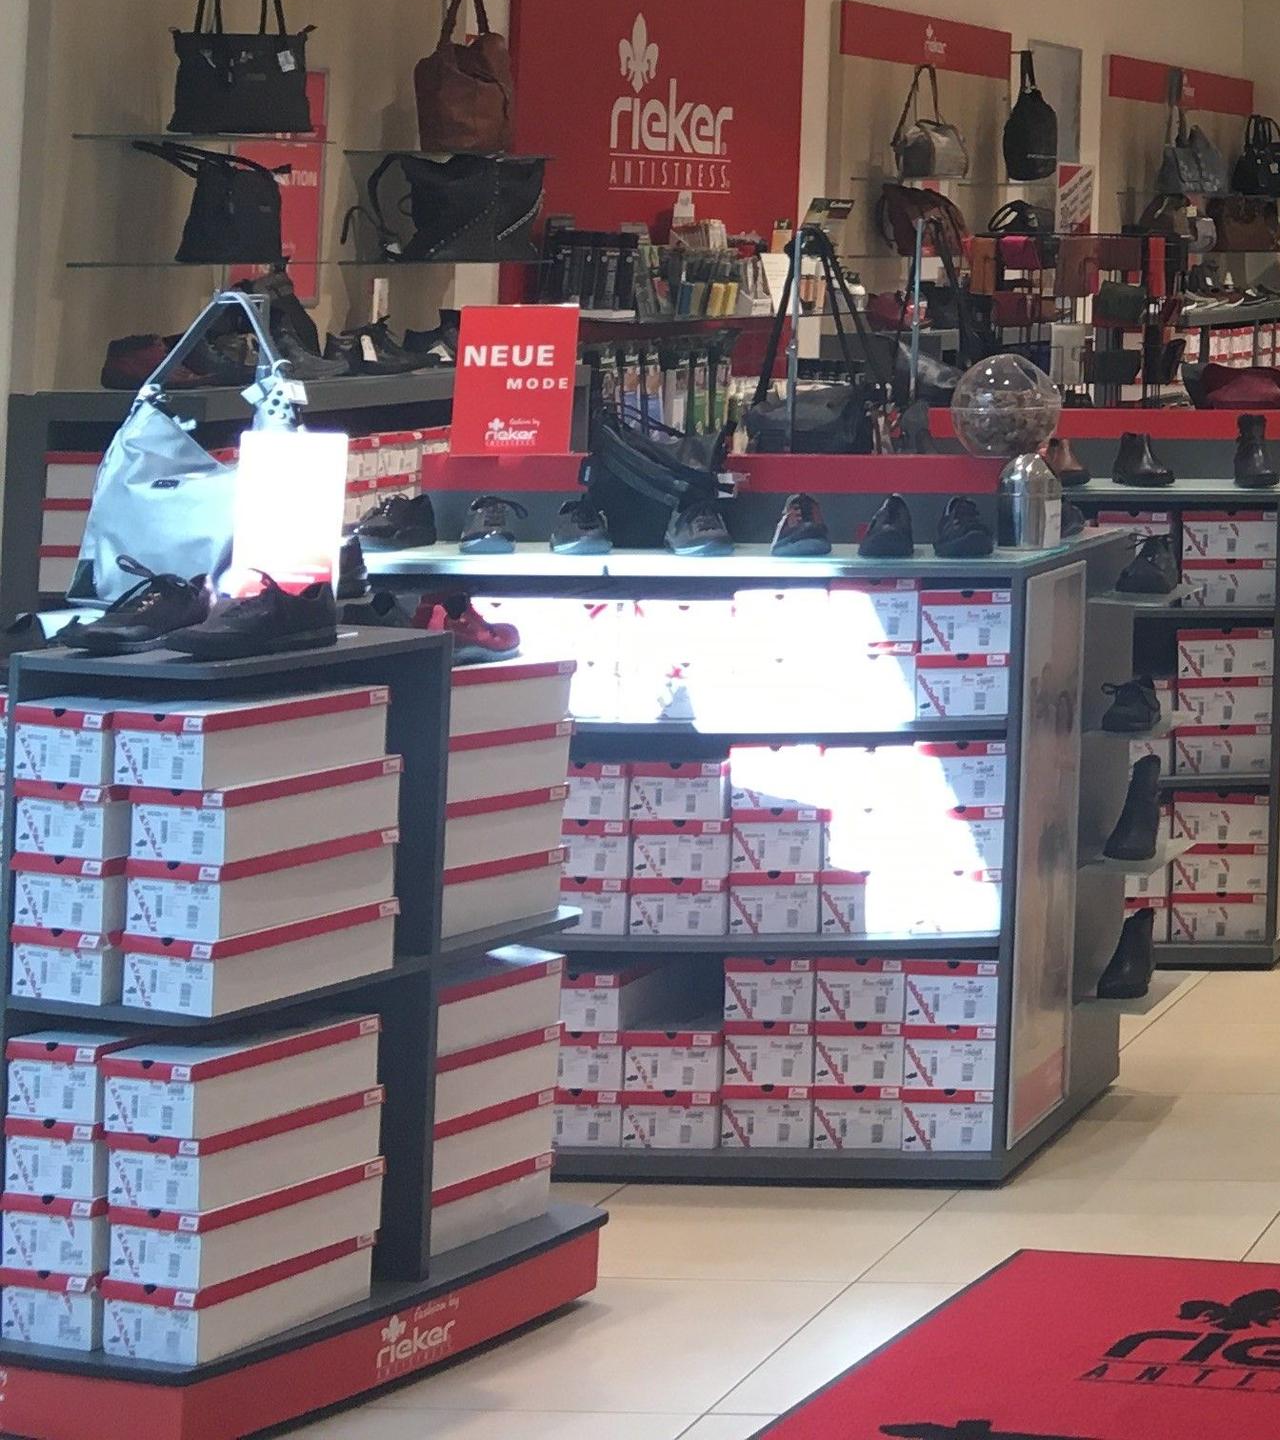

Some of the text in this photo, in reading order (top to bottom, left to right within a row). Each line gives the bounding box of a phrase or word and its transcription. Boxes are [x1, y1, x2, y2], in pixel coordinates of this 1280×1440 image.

[609, 78, 734, 156] rieker
[609, 160, 731, 188] ANTISTRESS
[463, 345, 555, 368] NEUE
[506, 377, 569, 391] MODE
[484, 426, 538, 441] rieker
[376, 1319, 457, 1369] rieker
